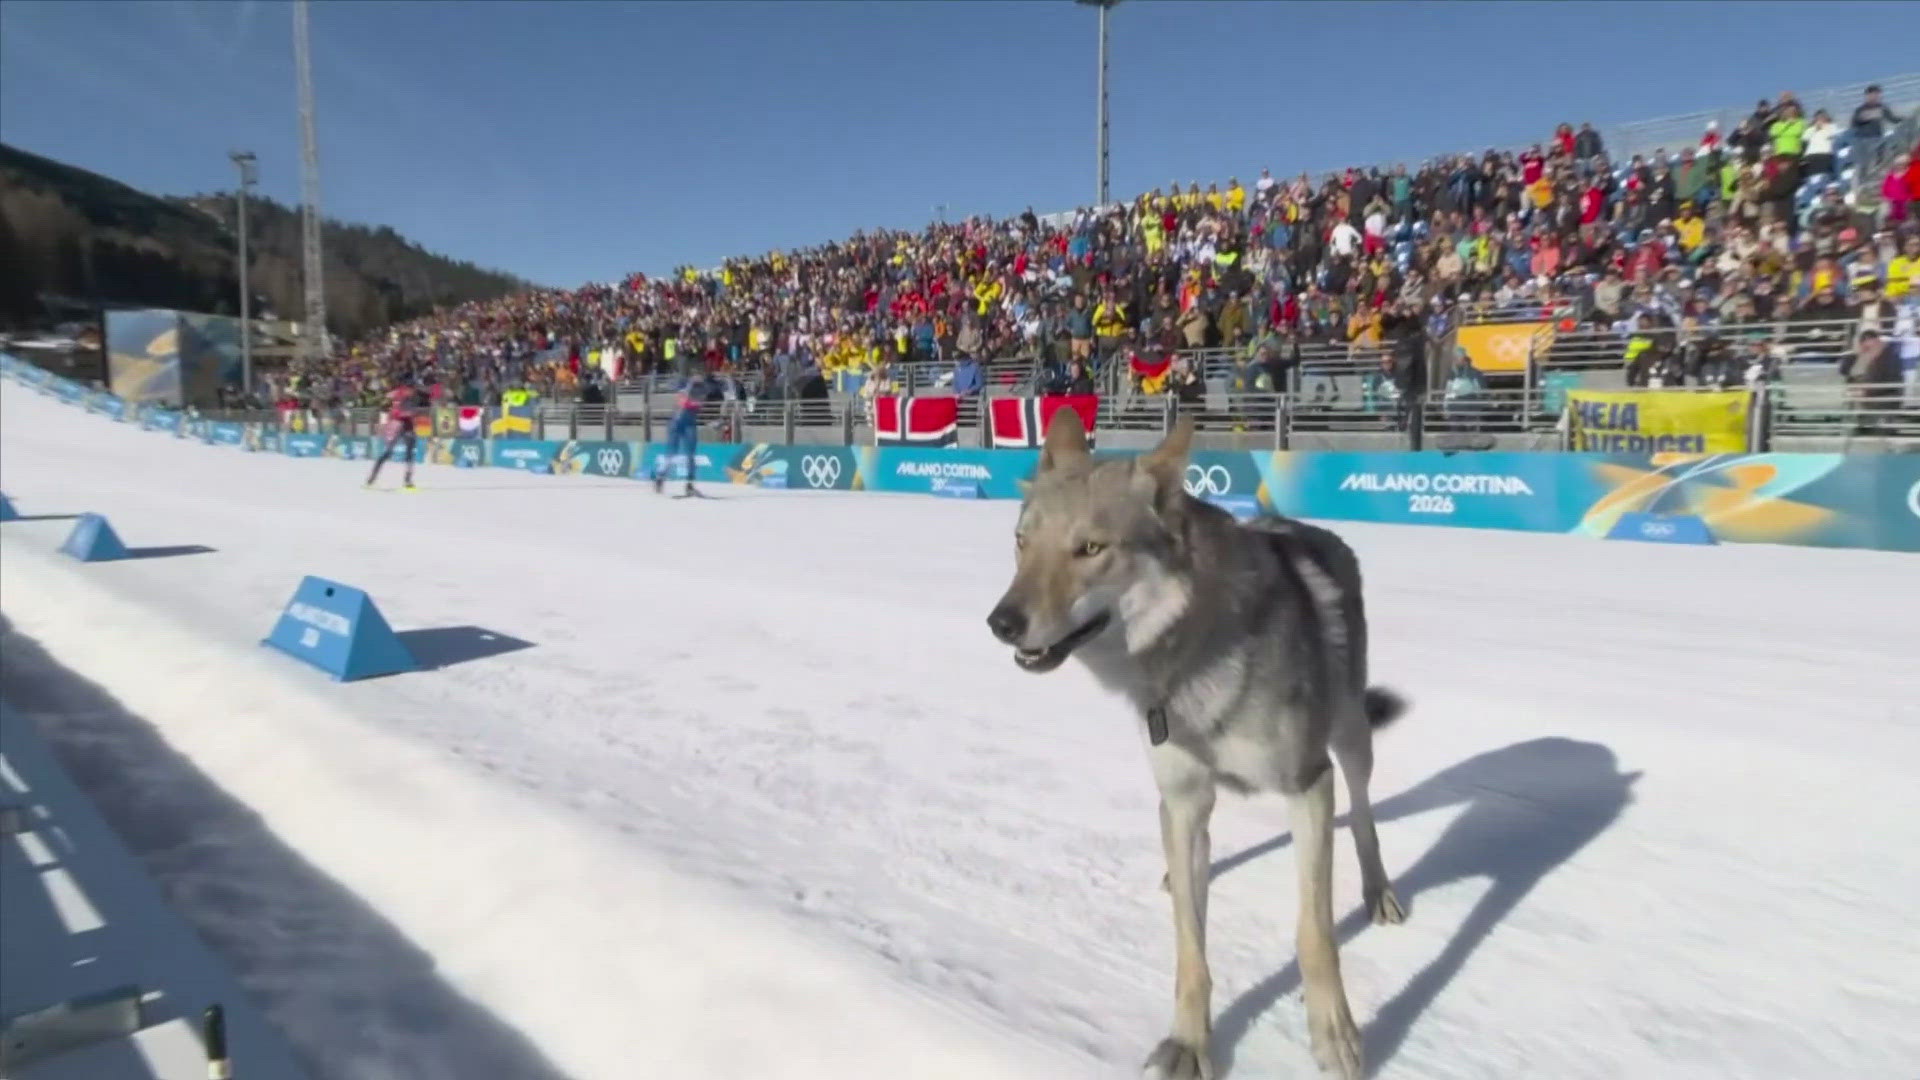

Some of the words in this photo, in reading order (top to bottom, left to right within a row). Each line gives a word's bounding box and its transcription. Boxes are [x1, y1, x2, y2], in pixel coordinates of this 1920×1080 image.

[943, 463, 992, 480] CORTINA
[1340, 473, 1430, 491] MILANO
[1432, 474, 1533, 495] CORTINA
[1408, 494, 1454, 513] 2026
